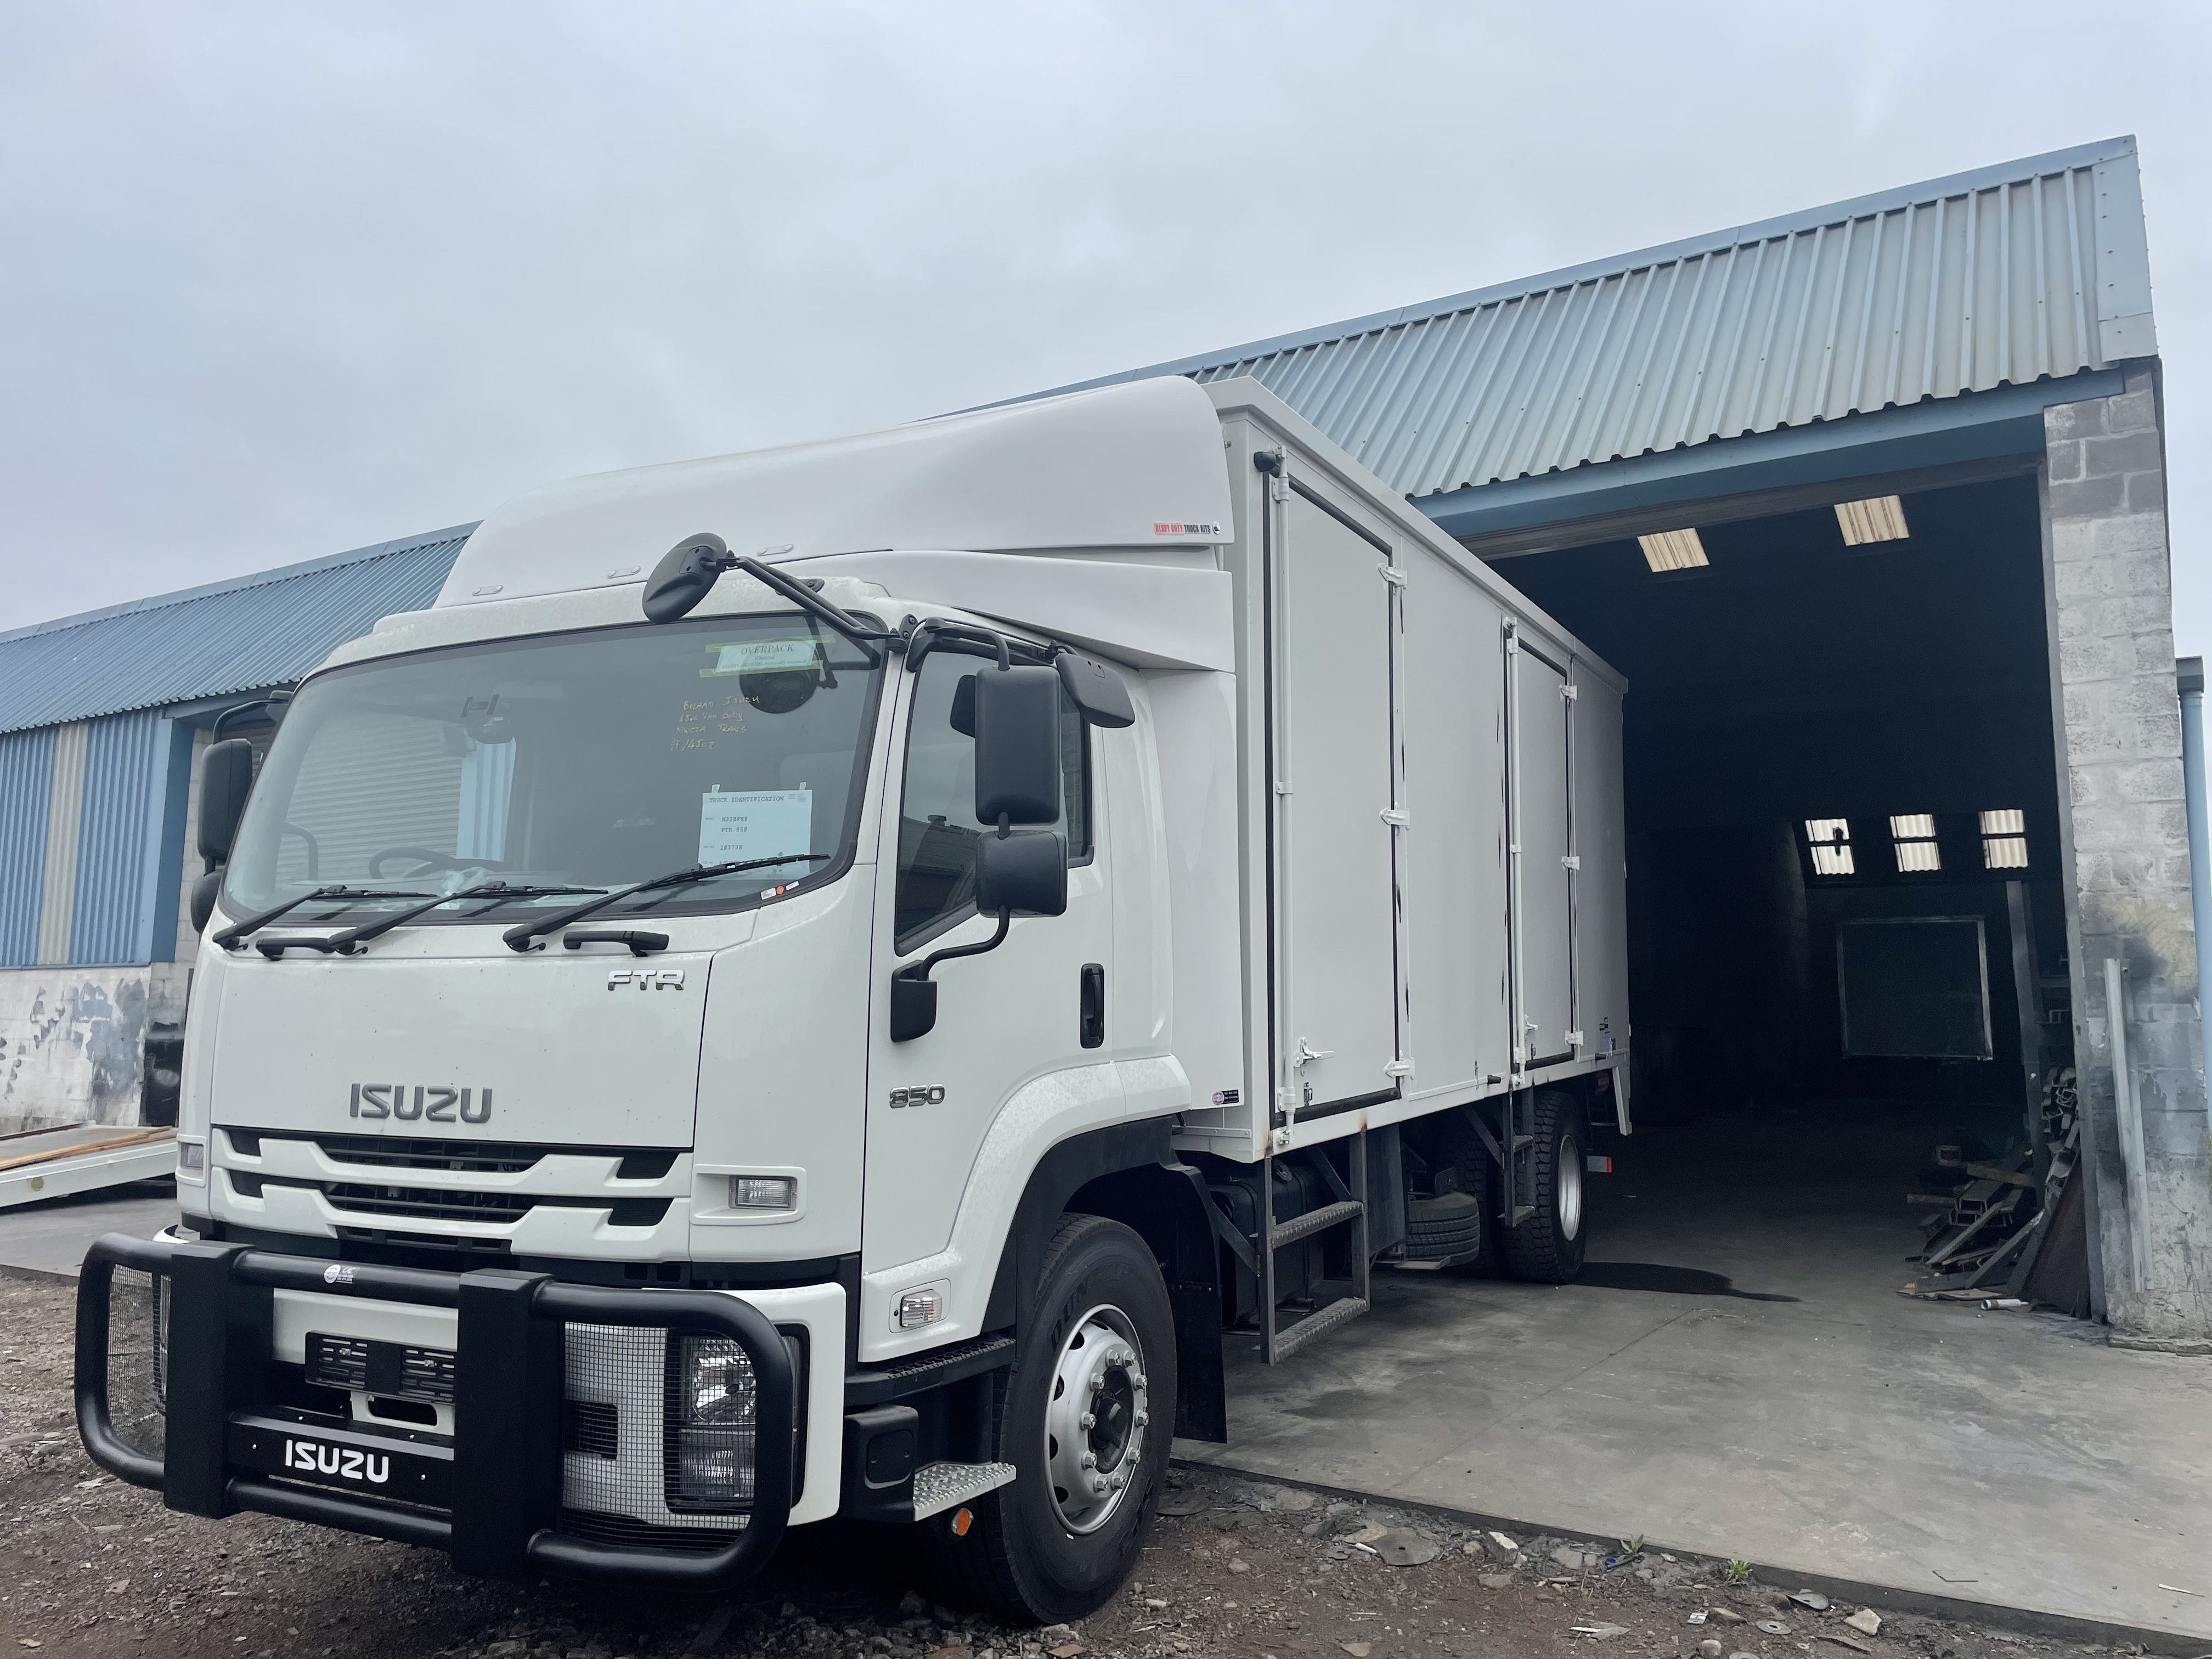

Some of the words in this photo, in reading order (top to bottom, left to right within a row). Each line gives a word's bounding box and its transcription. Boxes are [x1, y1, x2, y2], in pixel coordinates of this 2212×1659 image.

[1155, 524, 1170, 533] HEAVY
[1171, 524, 1183, 533] DUTY
[1183, 524, 1199, 533] TRUCK
[1200, 524, 1211, 533] KITS
[741, 644, 794, 655] OVERPACK
[608, 969, 685, 991] FTR
[349, 1082, 492, 1124] ISUZU
[889, 1084, 945, 1109] 850
[285, 1439, 390, 1483] ISUZU
